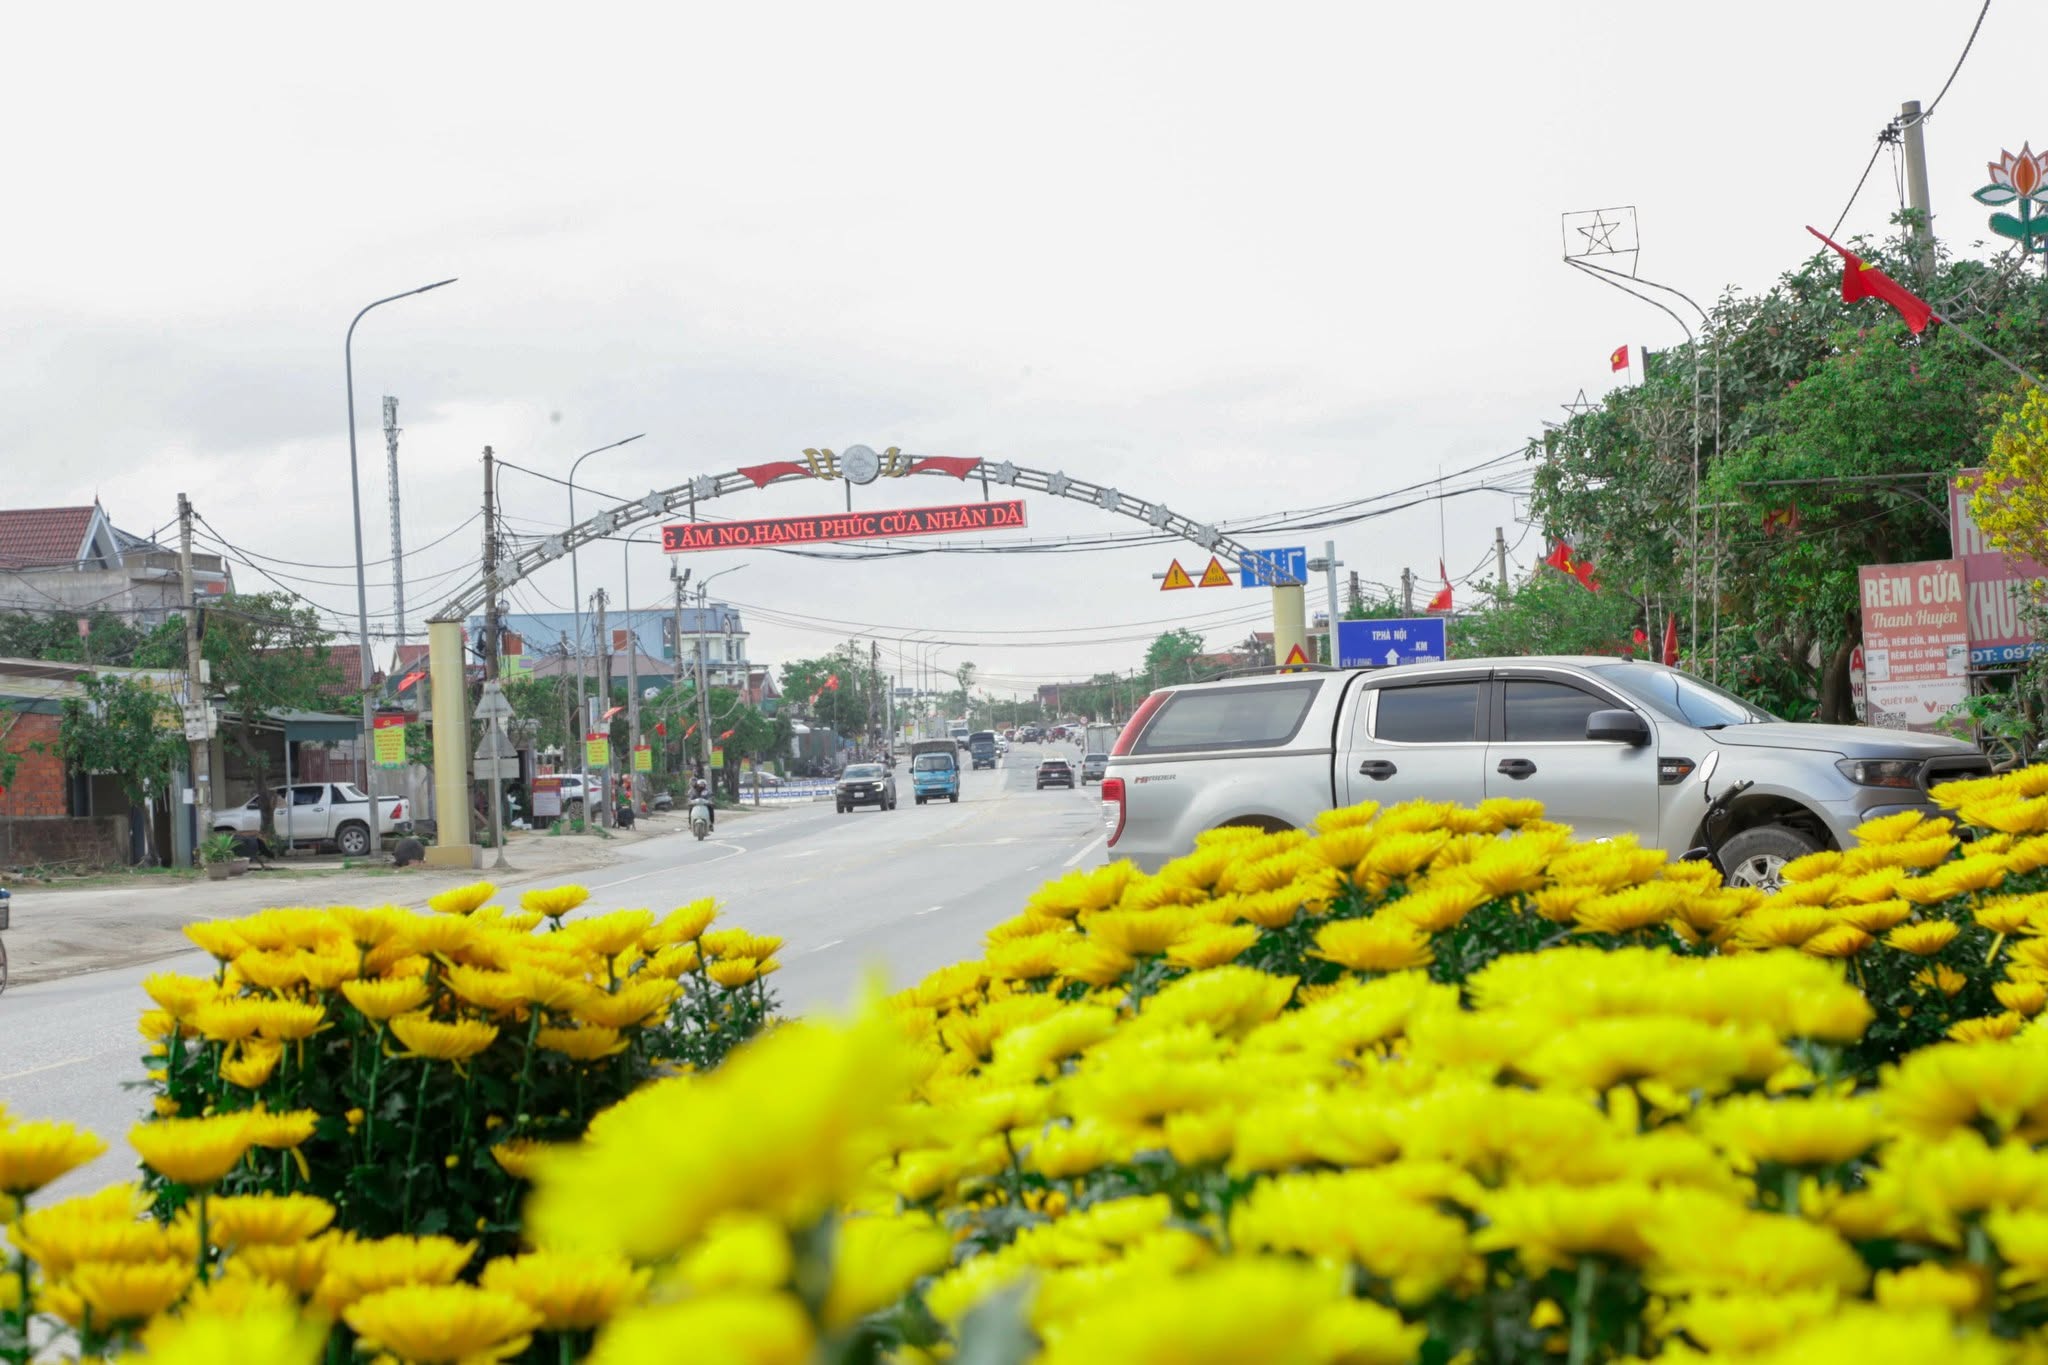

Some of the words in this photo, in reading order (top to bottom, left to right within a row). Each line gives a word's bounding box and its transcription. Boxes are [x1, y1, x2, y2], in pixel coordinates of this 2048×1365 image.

[680, 525, 714, 547] ẤM
[820, 514, 876, 538] PHÚC
[880, 511, 922, 533] CỦA
[926, 506, 986, 530] NHÂN
[1864, 572, 1912, 608] RÈM
[1918, 564, 1961, 605] CỬA
[1872, 611, 1913, 628] Thanh
[1916, 604, 1958, 629] Huyền
